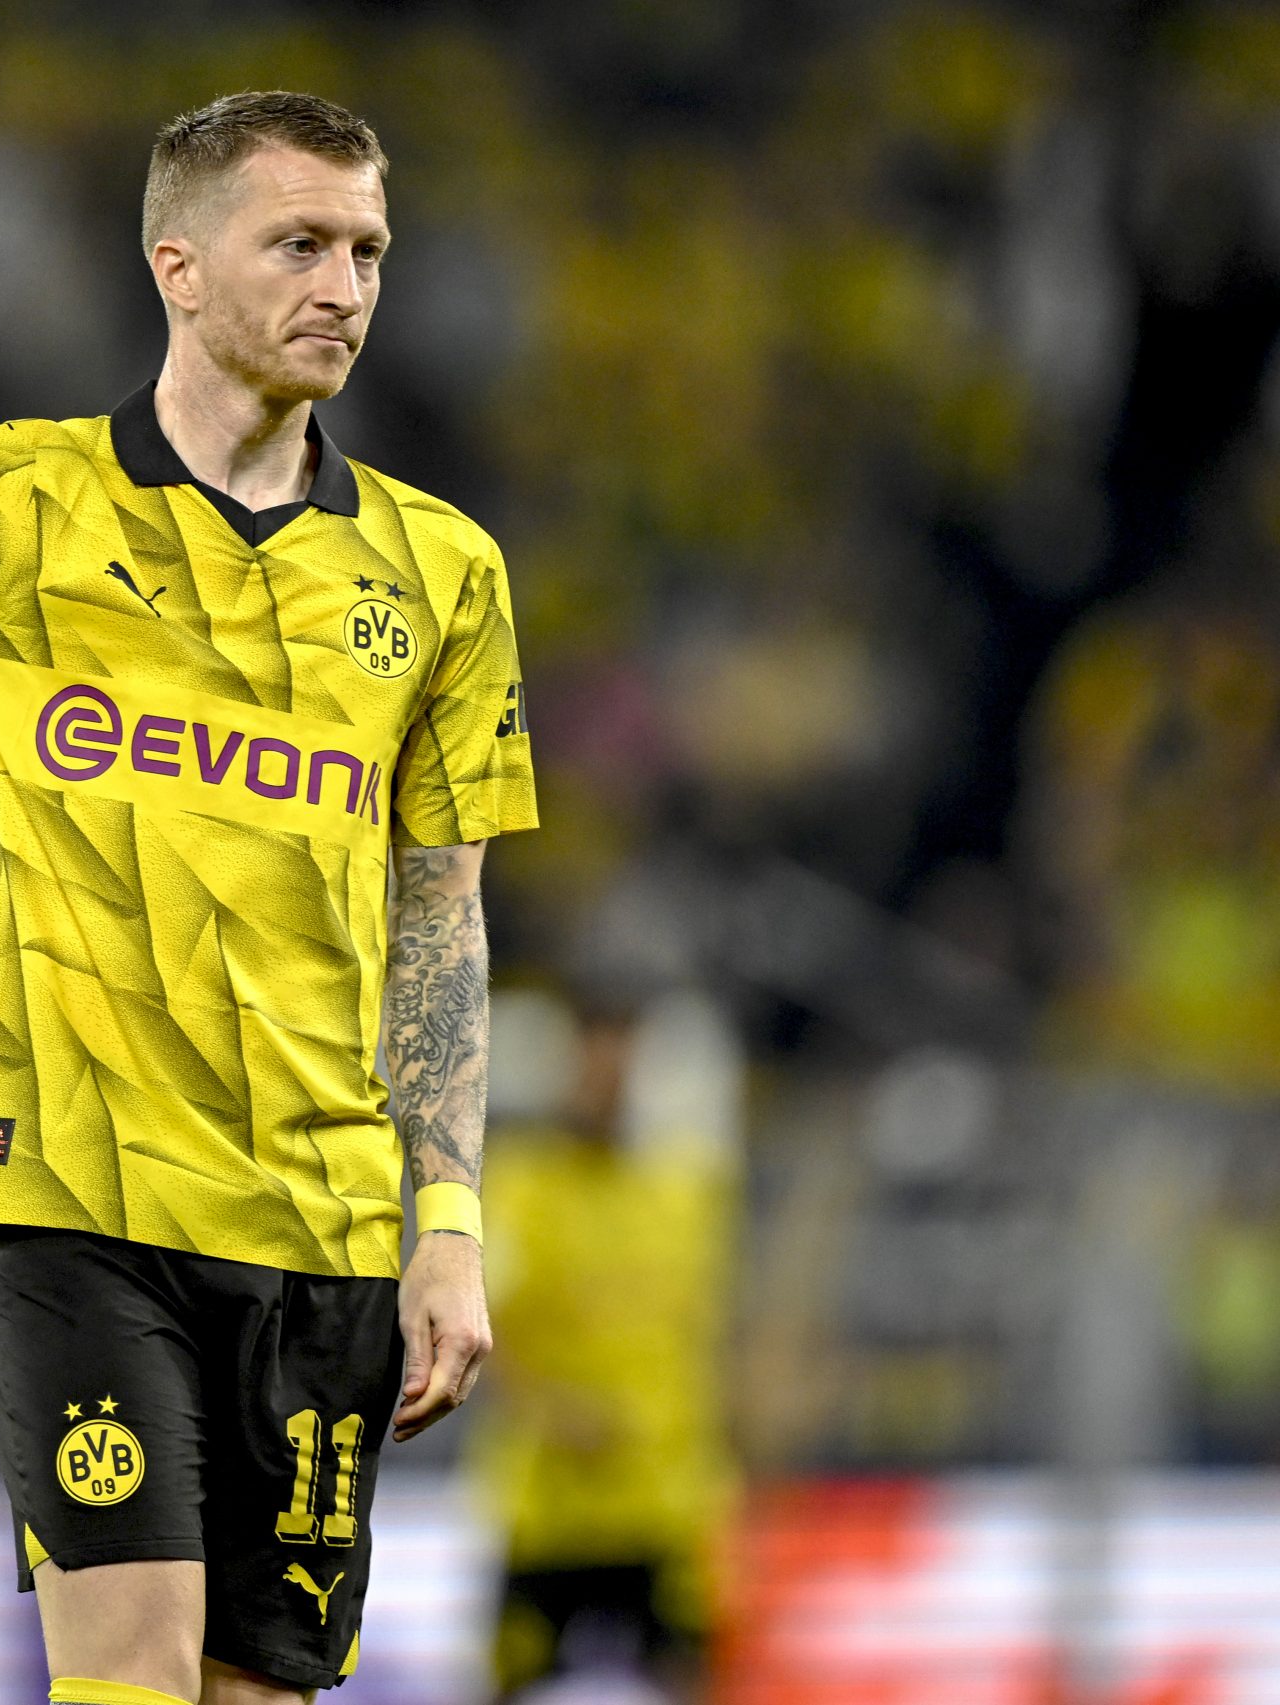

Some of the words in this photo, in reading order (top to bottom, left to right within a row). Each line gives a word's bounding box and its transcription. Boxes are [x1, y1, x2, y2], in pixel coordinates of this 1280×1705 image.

[354, 606, 409, 659] BVB
[370, 653, 390, 671] 09
[68, 1429, 134, 1483] BVB
[275, 1409, 364, 1546] 11
[92, 1477, 116, 1496] 09
